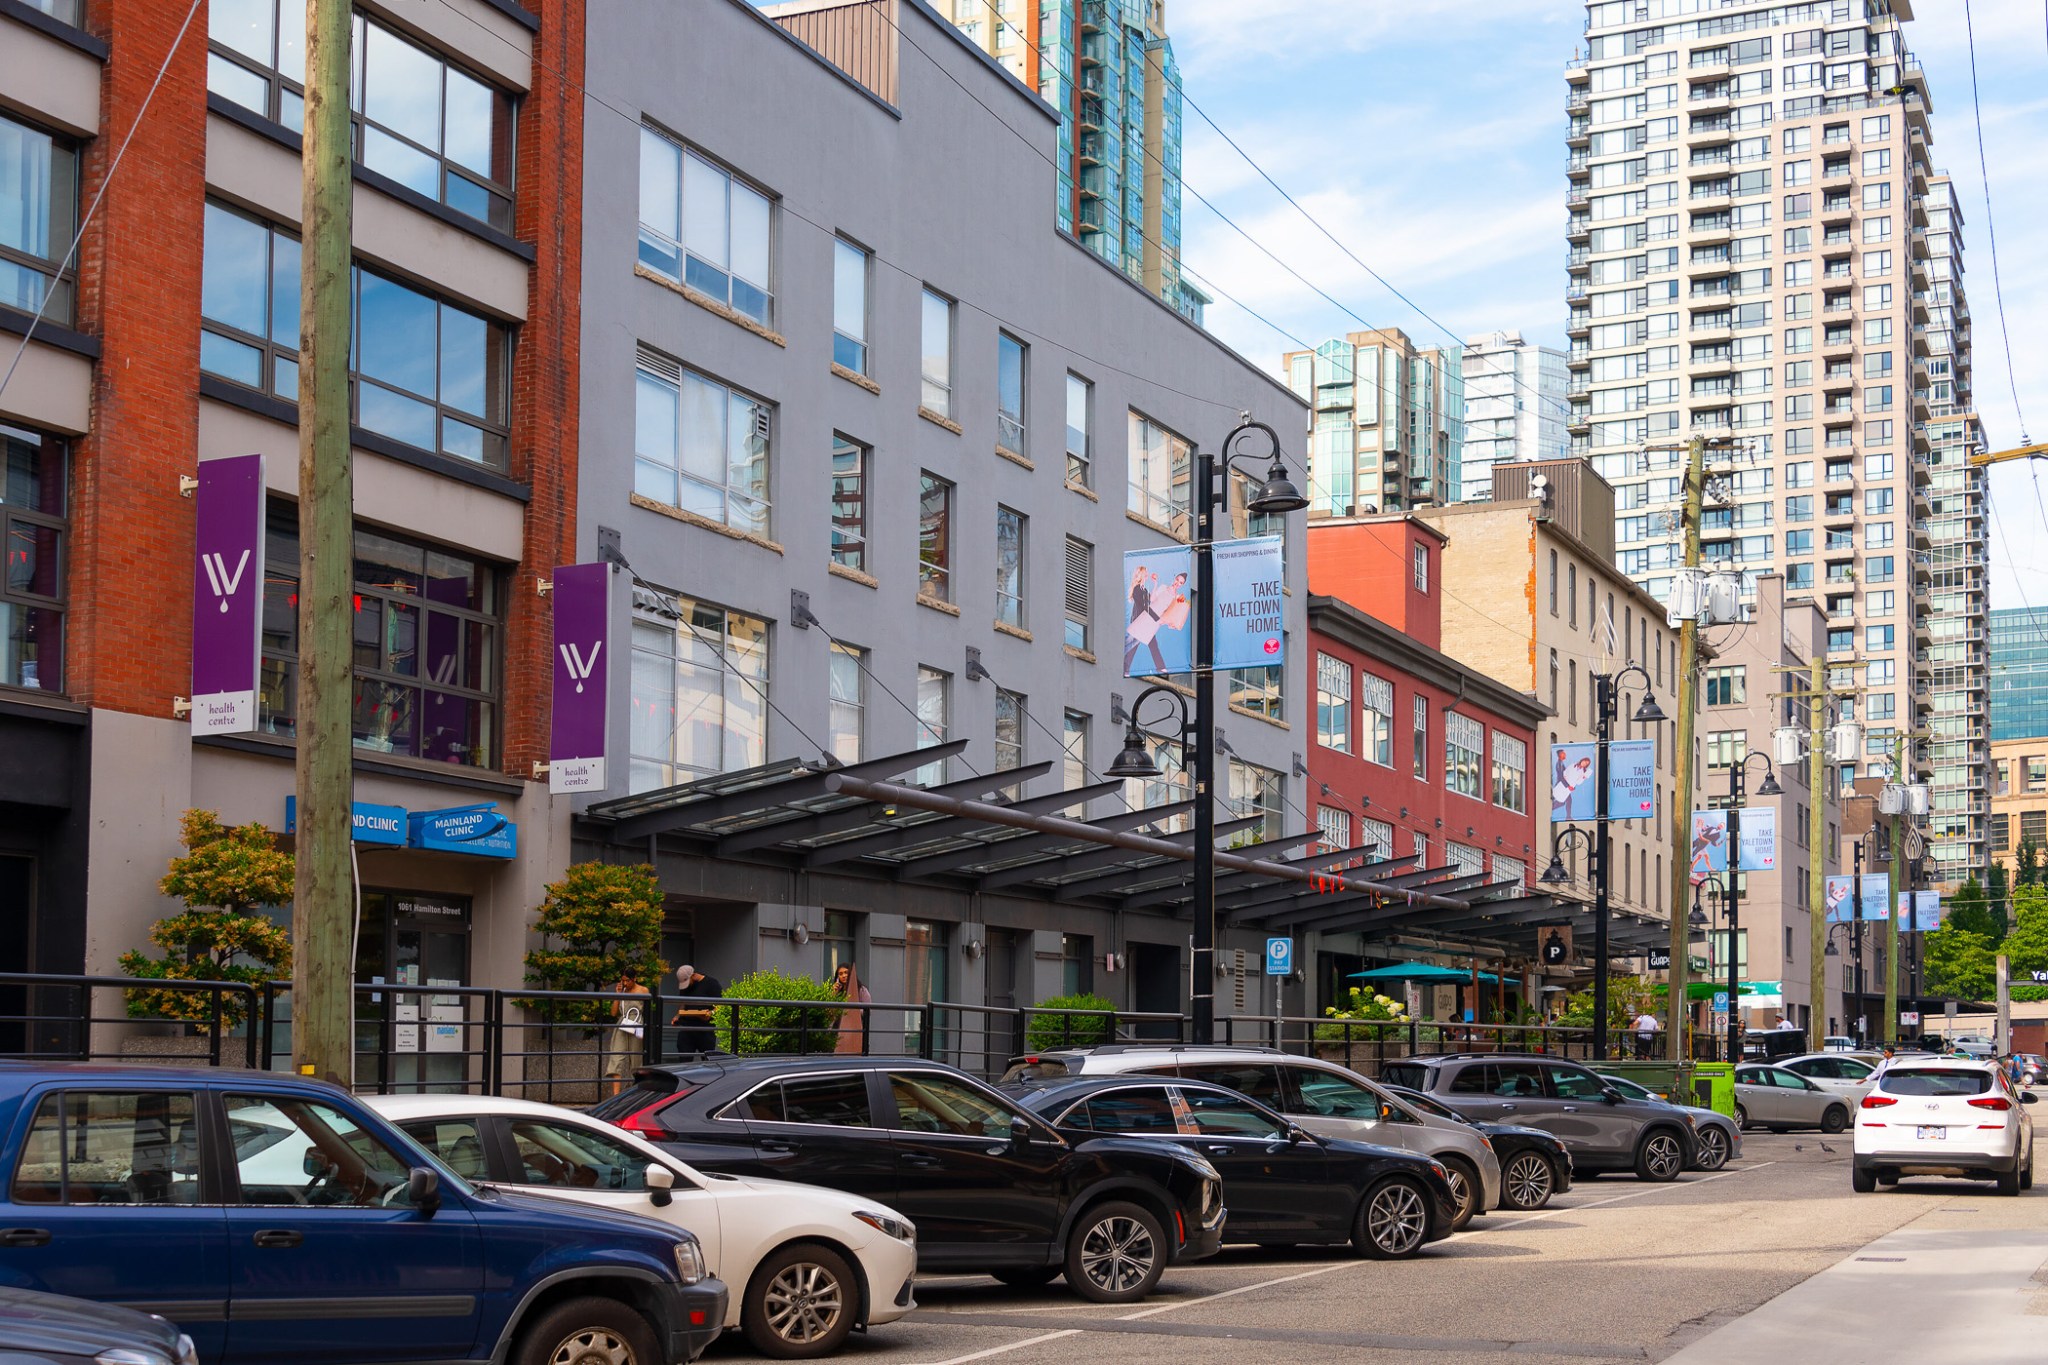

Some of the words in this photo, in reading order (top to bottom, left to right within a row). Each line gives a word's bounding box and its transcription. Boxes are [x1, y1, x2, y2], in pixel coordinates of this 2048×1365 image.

[1216, 552, 1230, 560] FRESH
[1238, 550, 1259, 558] SHOPPING
[1264, 548, 1278, 556] DINING
[1251, 580, 1280, 598] TAKE
[1219, 598, 1280, 618] YALETOWN
[1246, 616, 1280, 634] HOME
[208, 702, 235, 714] health
[208, 716, 236, 726] centre
[564, 766, 588, 776] health
[1633, 766, 1652, 776] TAKE
[564, 777, 589, 786] centre
[1612, 777, 1652, 788] YALETOWN
[1629, 788, 1651, 798] HOME
[366, 816, 399, 832] CLINIC
[435, 814, 483, 829] MAINLAND
[444, 826, 474, 838] CLINIC
[1758, 828, 1772, 837] TAKE
[1742, 837, 1772, 846] YALETOWN
[1754, 846, 1772, 854] HOME
[414, 904, 442, 914] Hamilton
[442, 906, 462, 916] Street
[1550, 946, 1560, 958] P
